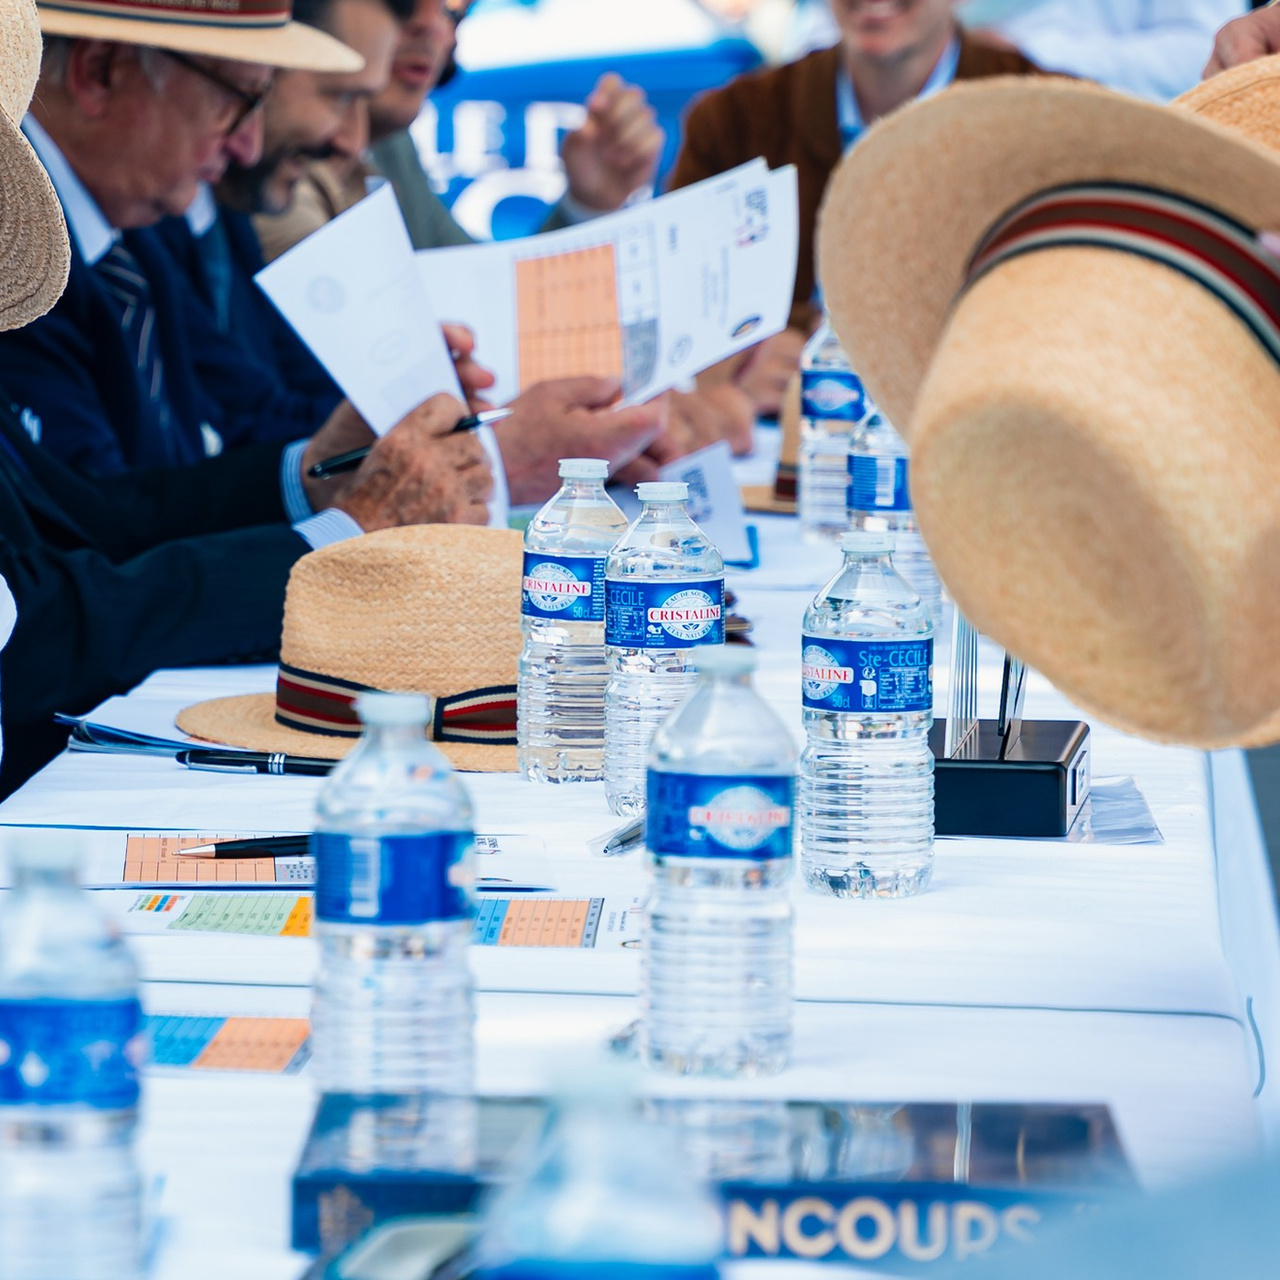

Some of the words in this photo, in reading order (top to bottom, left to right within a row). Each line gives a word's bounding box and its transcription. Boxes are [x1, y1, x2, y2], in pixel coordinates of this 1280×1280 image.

[524, 578, 587, 594] CRISTALINE
[606, 589, 645, 606] -CECILE
[649, 607, 720, 621] CRISTALINE
[858, 649, 928, 667] Ste-CECILE
[726, 1194, 1044, 1262] NCOURS
